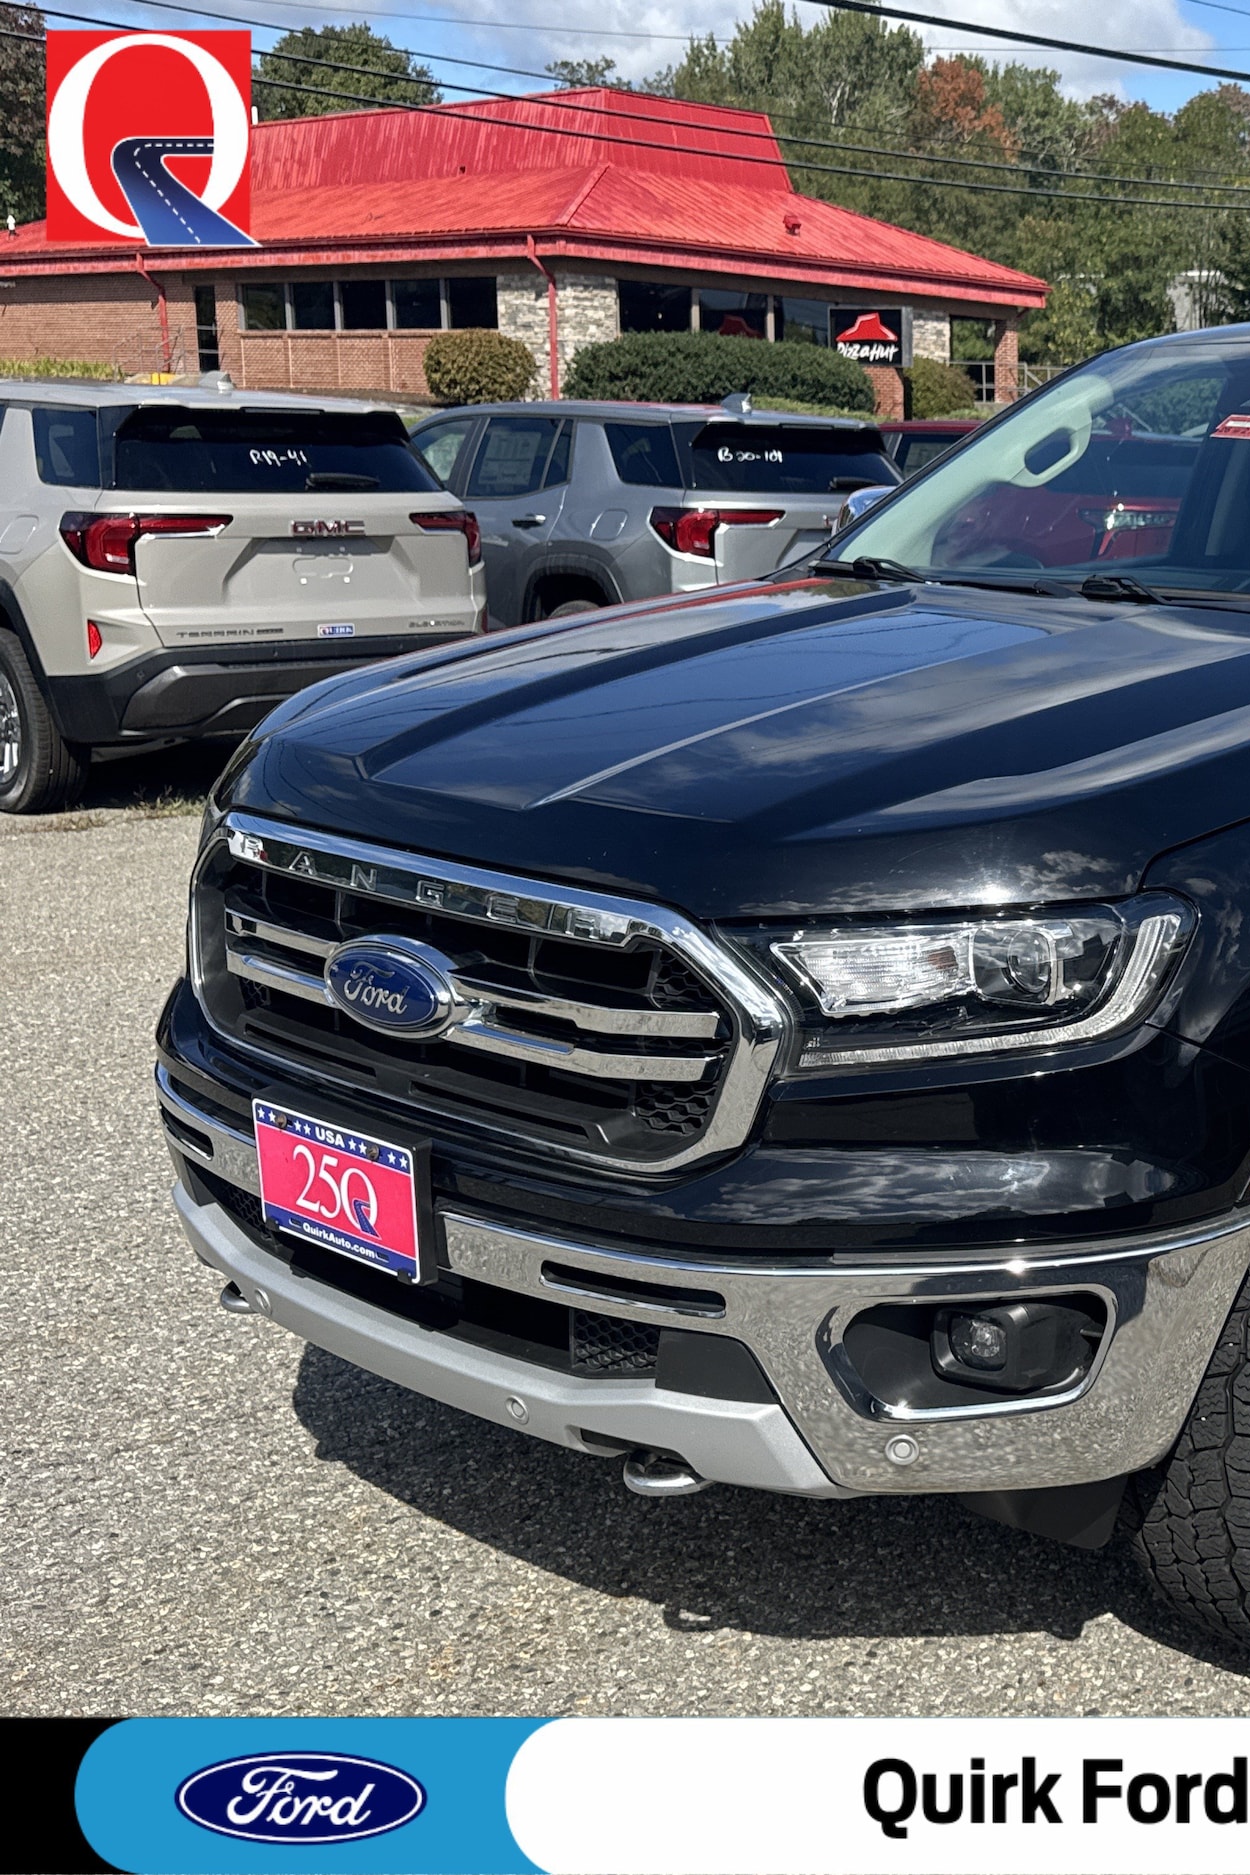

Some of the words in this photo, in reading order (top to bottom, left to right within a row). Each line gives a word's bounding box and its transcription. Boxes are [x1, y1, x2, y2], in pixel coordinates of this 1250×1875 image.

[291, 519, 366, 535] GMC
[240, 833, 601, 941] RANGER
[343, 960, 407, 1016] Ford
[315, 1126, 345, 1149] USA
[302, 1222, 376, 1259] QuirkAuto.com
